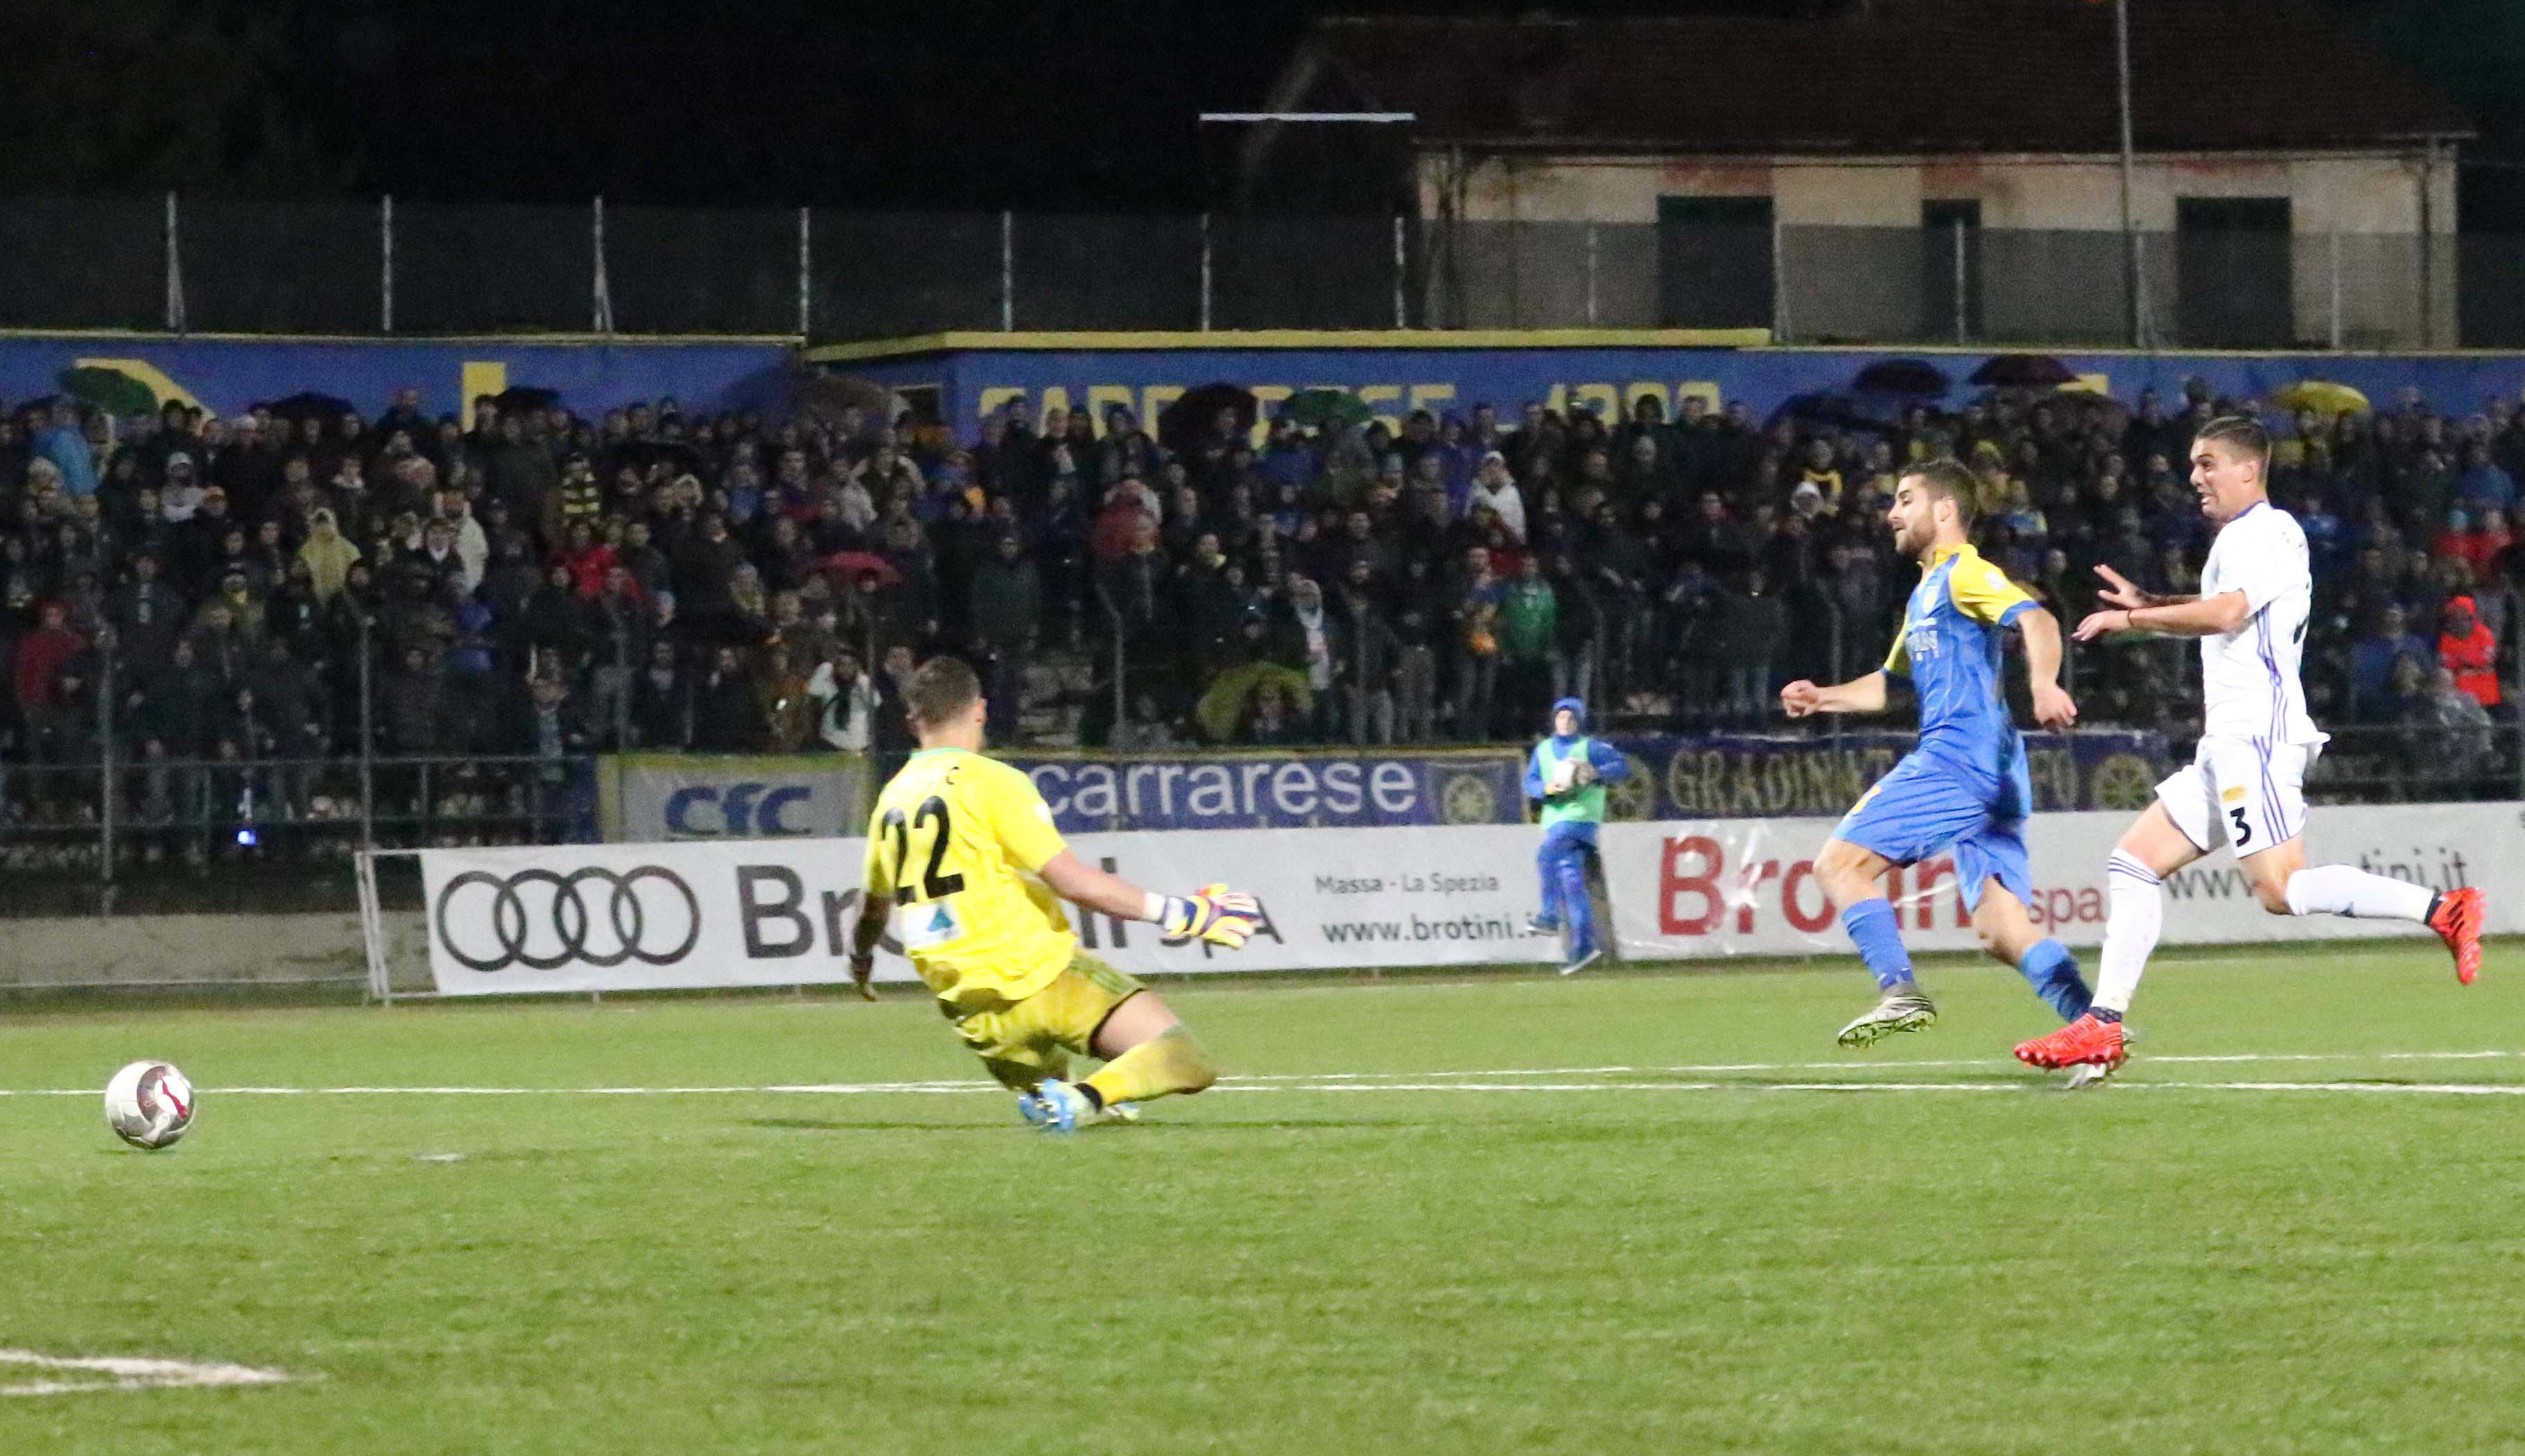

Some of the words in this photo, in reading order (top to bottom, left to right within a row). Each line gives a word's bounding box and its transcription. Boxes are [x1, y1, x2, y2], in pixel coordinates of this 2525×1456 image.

[1030, 761, 1417, 817] carrarese
[2230, 806, 2252, 847] 3
[882, 795, 965, 906] 22
[1314, 876, 1384, 894] Massa
[1401, 874, 1423, 892] La
[1429, 872, 1499, 897] Spezia
[1321, 911, 1538, 942] www.brotini.
